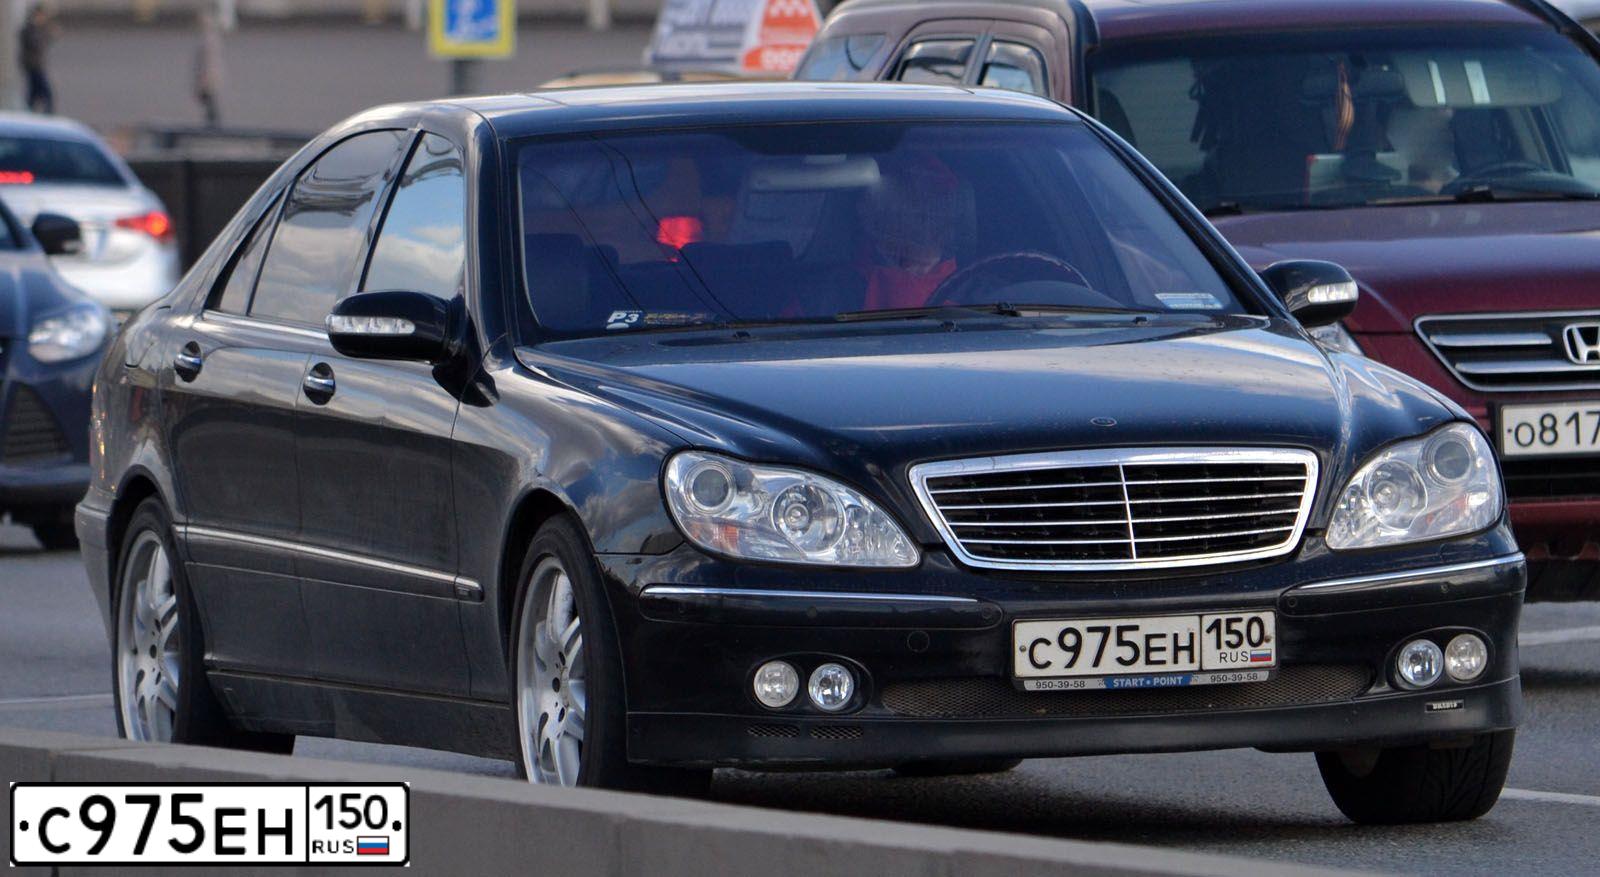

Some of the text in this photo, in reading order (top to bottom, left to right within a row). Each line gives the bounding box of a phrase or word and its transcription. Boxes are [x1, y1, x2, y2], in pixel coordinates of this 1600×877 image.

[1205, 616, 1265, 650] 150
[1028, 624, 1195, 669] C975EH
[1219, 650, 1249, 664] RUS
[1113, 676, 1183, 688] START POINT
[1210, 672, 1258, 683] 950-39-58
[1035, 680, 1086, 689] 950-39-58
